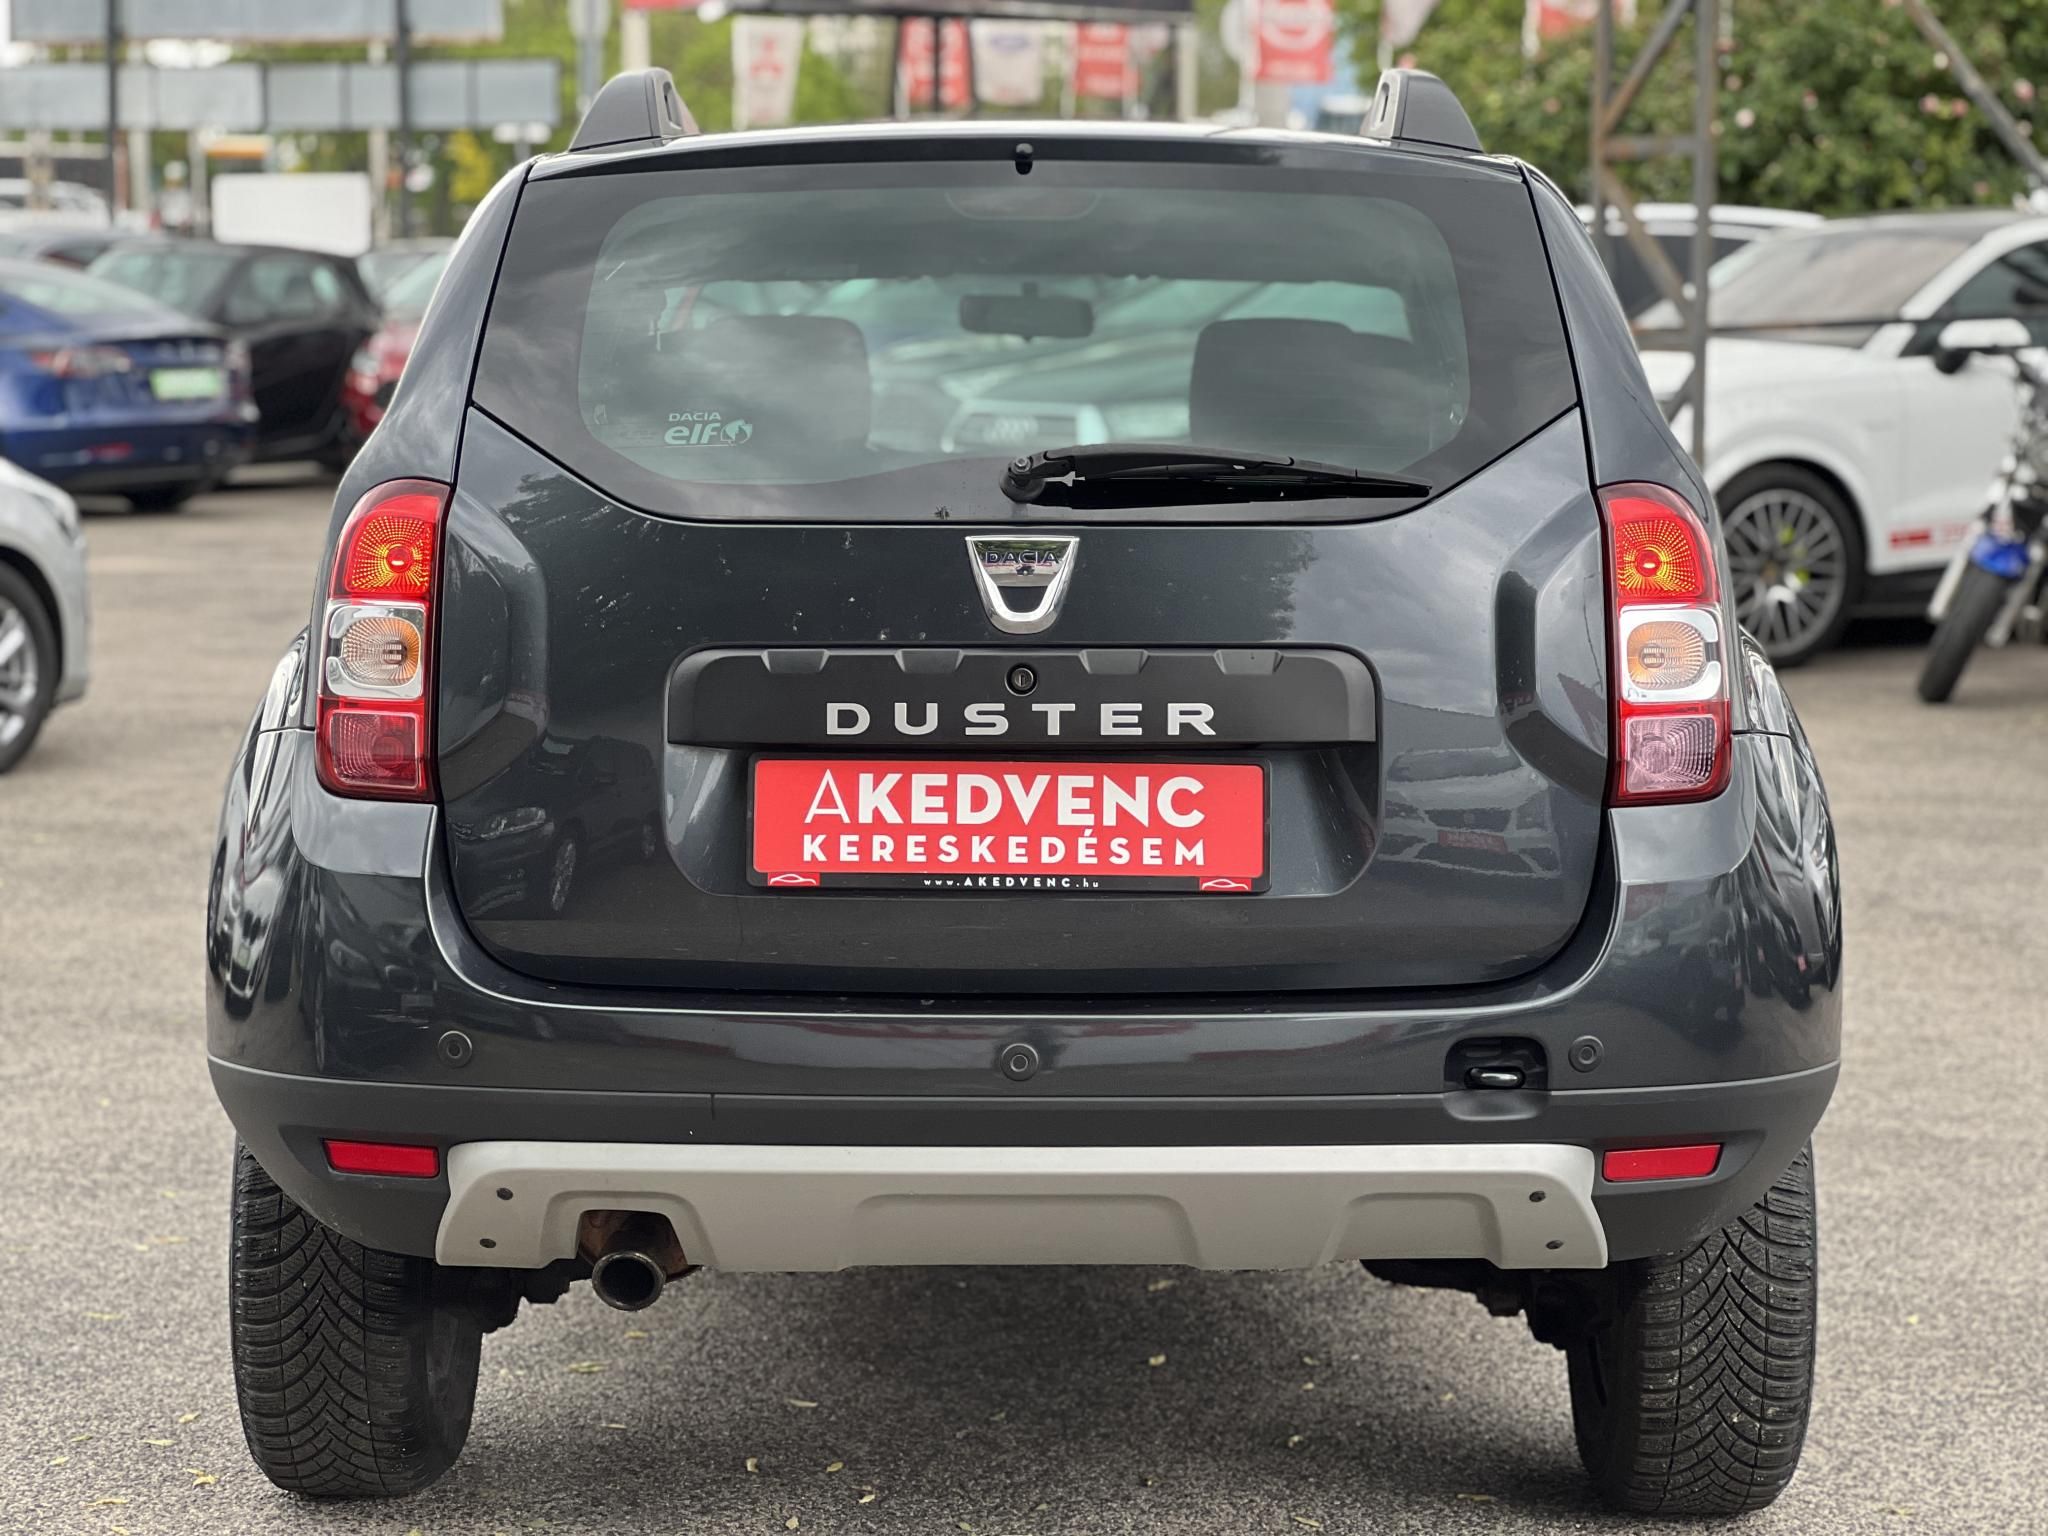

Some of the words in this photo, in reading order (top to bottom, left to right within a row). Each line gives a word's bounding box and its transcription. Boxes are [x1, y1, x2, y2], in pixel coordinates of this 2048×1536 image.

[668, 412, 721, 421] DACIA
[985, 550, 1060, 564] DACIA
[826, 702, 1217, 736] DUSTER
[804, 769, 1206, 829] AKEDVENC
[803, 829, 1205, 866] KERESKEDÉSEM
[923, 876, 1099, 889] www.AKEDVENC.hu
